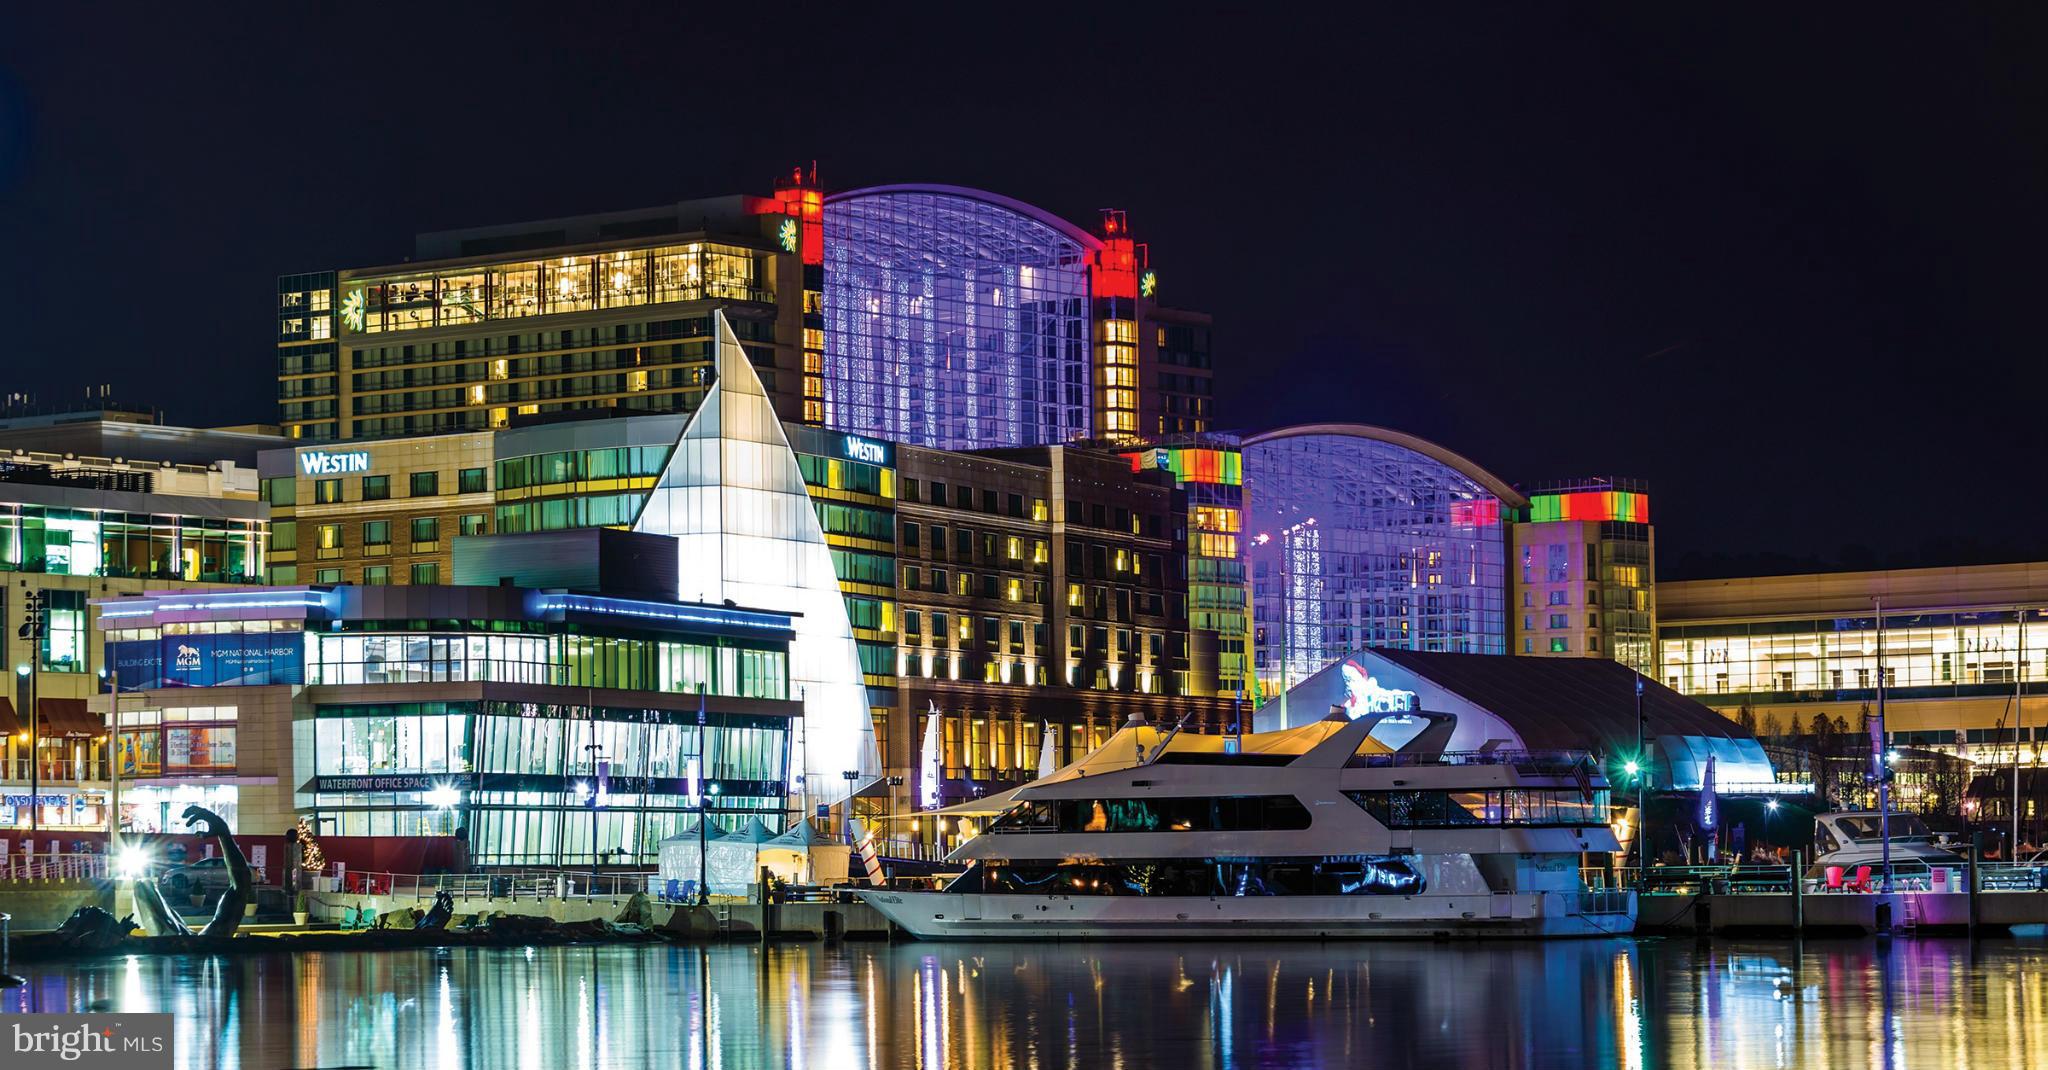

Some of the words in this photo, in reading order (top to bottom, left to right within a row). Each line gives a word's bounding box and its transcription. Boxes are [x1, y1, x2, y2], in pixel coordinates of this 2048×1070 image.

[847, 436, 884, 463] WESTIN
[301, 452, 368, 474] WESTIN
[229, 649, 263, 657] NATONAL
[264, 648, 294, 656] HARBOR
[176, 657, 201, 666] MGM
[319, 778, 373, 790] WATERFRONT
[375, 777, 402, 789] OFFICE
[404, 777, 429, 788] SPACE
